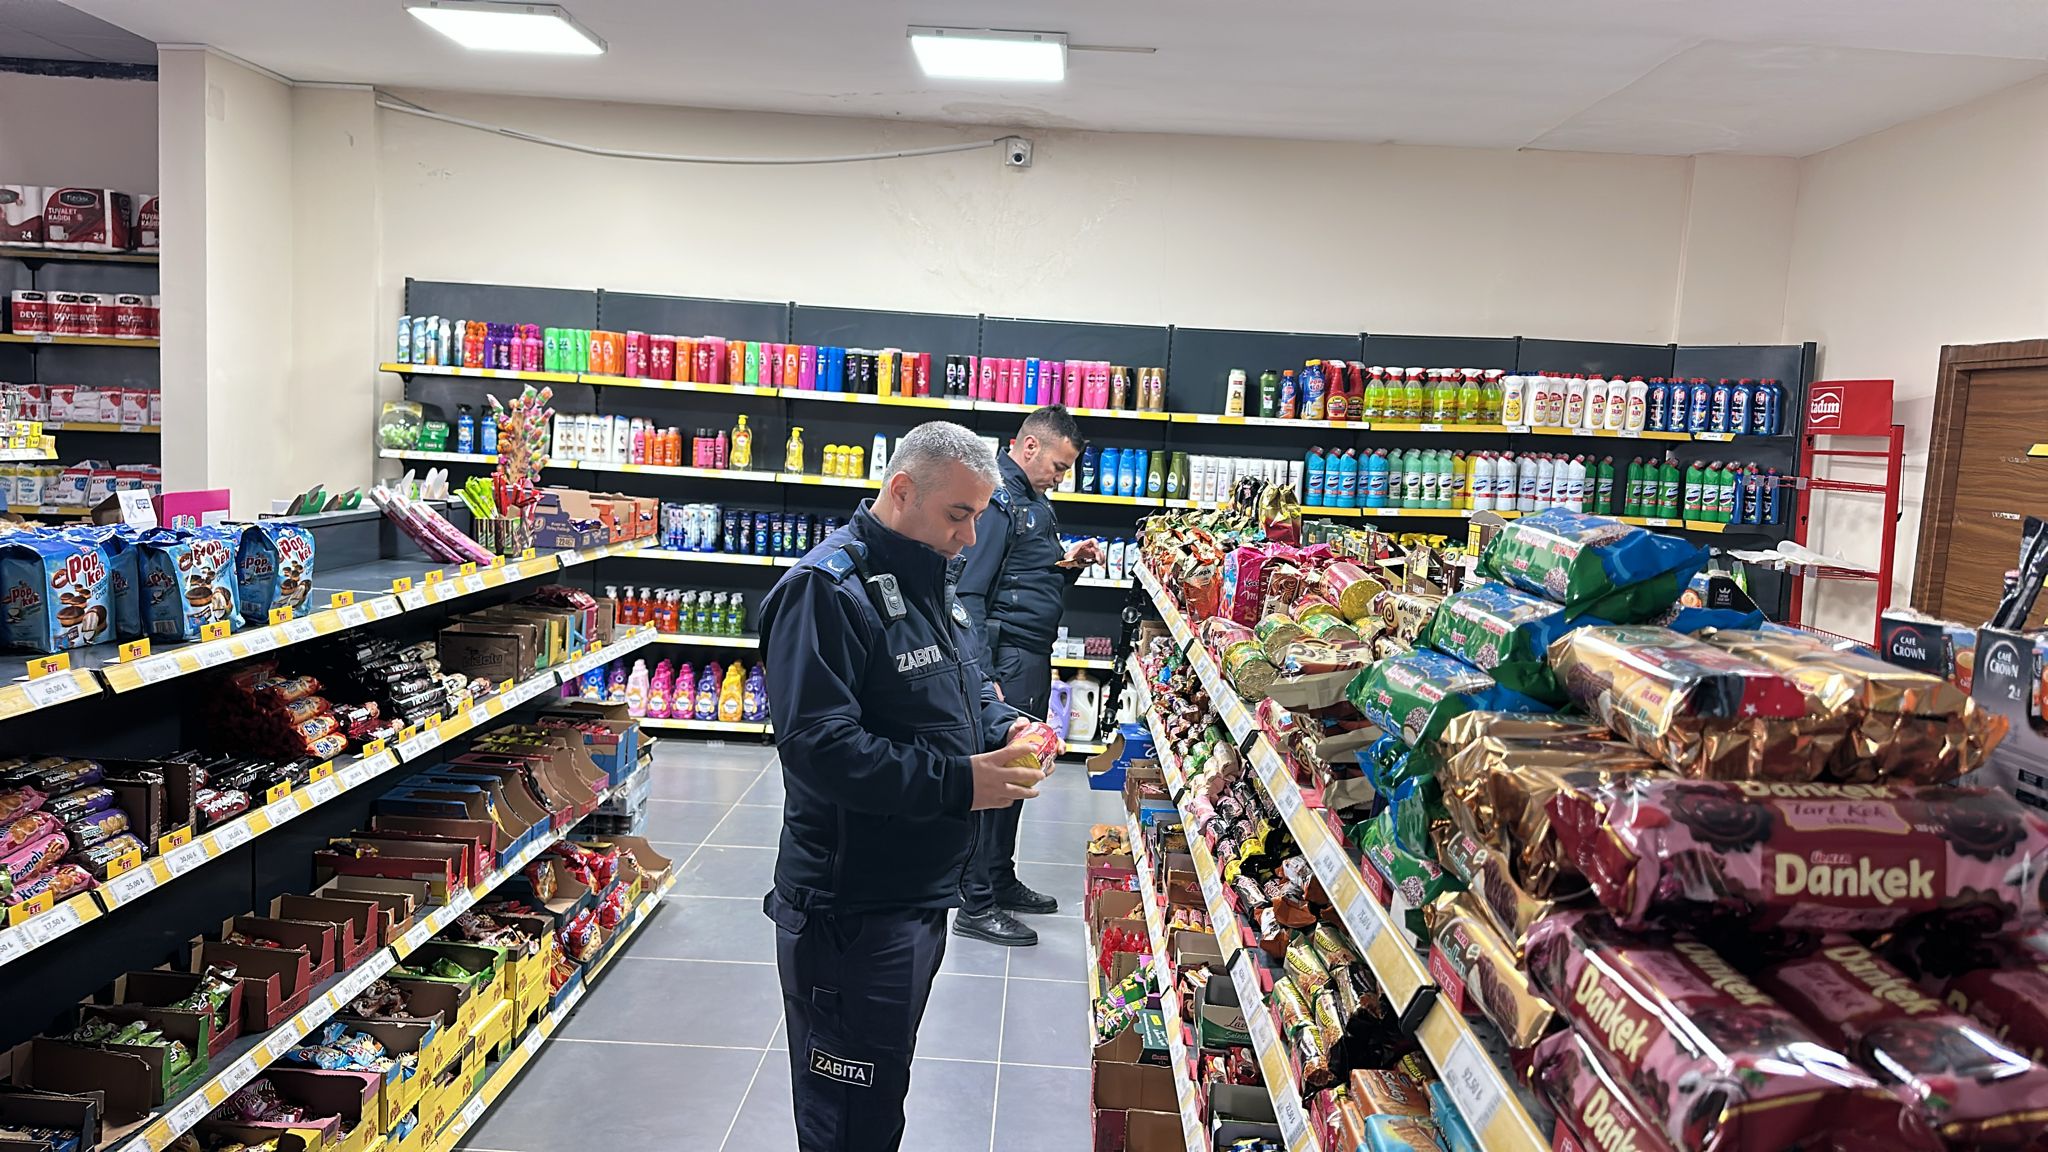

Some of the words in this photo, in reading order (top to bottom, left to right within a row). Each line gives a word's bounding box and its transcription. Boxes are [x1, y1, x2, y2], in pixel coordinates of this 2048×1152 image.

[21, 231, 32, 239] 24
[92, 232, 104, 240] 24
[1810, 399, 1840, 413] tadım
[277, 536, 305, 558] Pop
[896, 644, 943, 673] ZABITA
[1892, 643, 1926, 661] CROWN
[1989, 659, 2020, 679] CROWN
[1738, 780, 1898, 800] Dankek
[1793, 802, 1838, 816] Tart
[1775, 852, 1935, 906] Dankek
[1575, 963, 1649, 1064] Dankek
[815, 1055, 866, 1081] ZABITA
